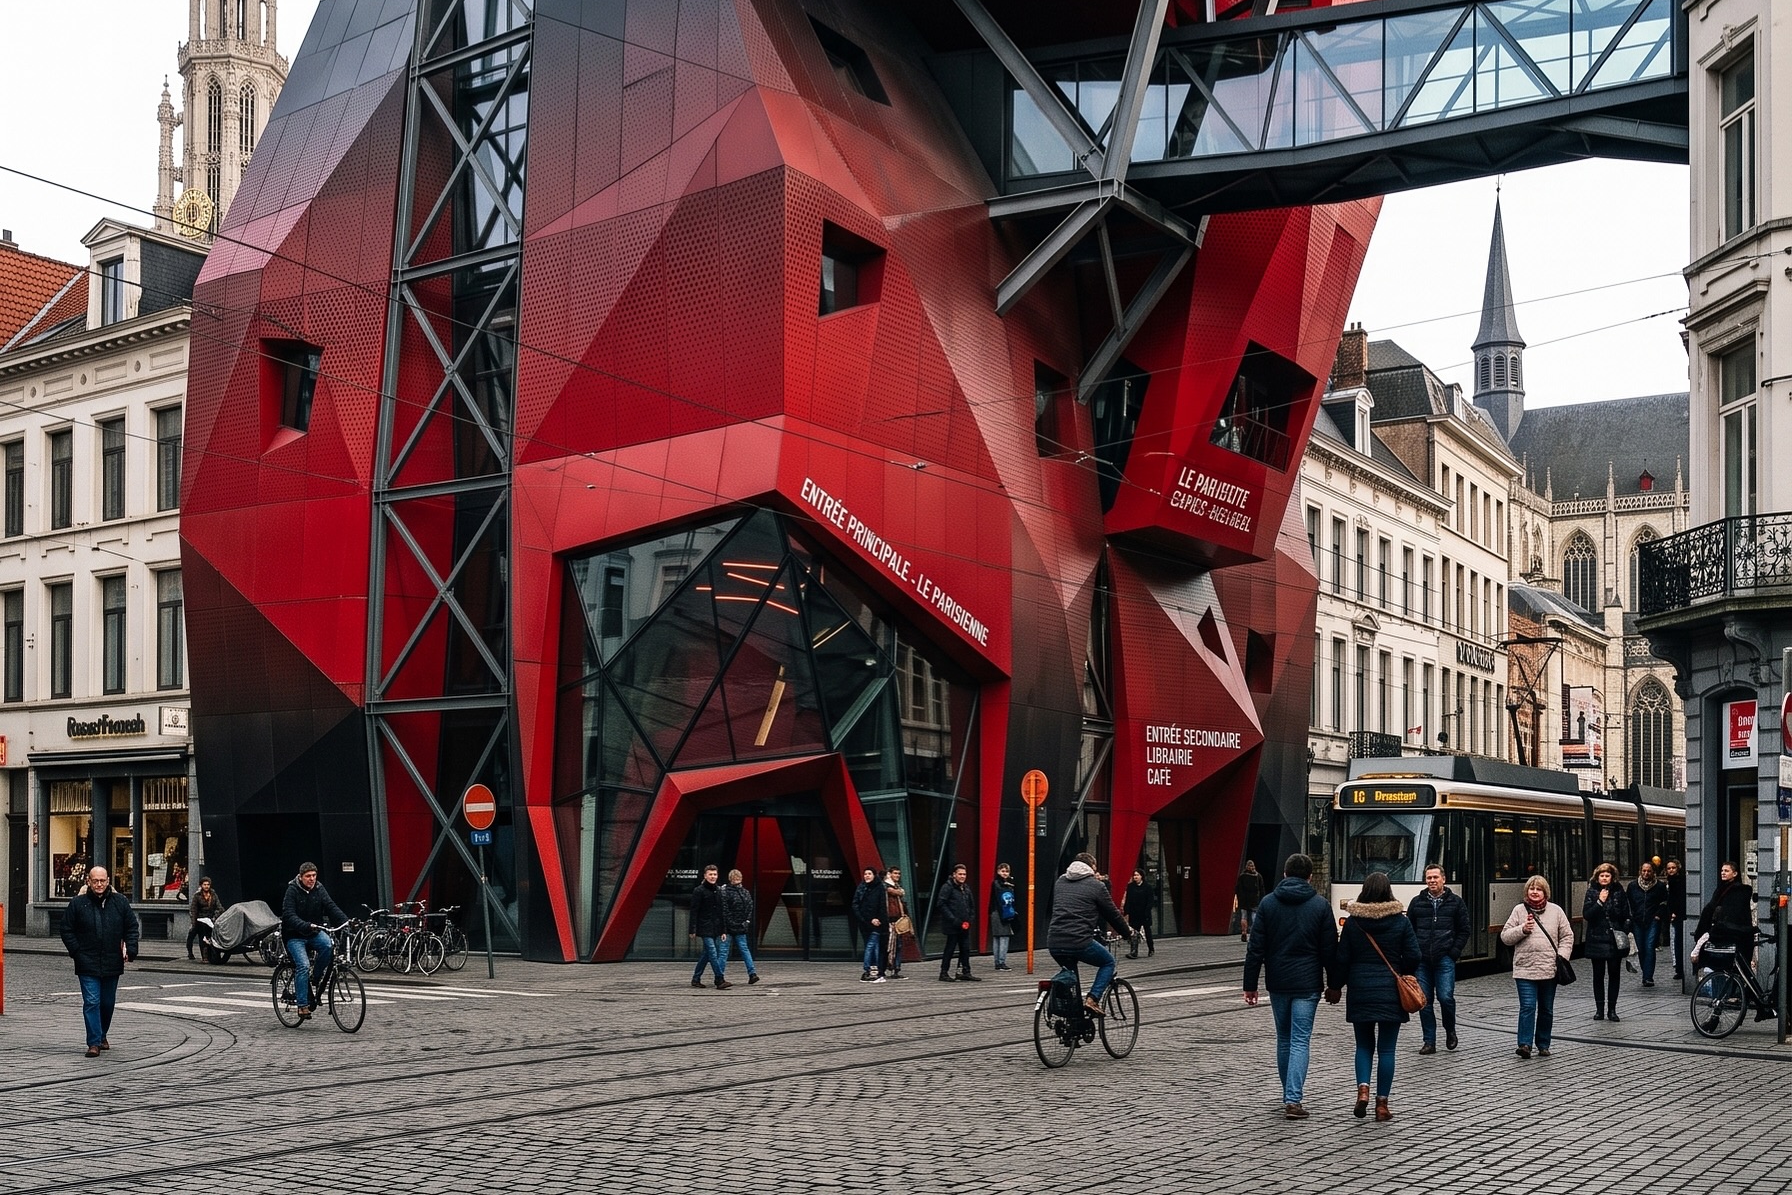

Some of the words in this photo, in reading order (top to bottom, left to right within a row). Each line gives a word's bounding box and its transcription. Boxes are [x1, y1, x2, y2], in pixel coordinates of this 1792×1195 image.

[1177, 466, 1196, 489] LE
[800, 477, 848, 530] ENTRÉE
[846, 514, 911, 582] PRINCIPALE
[916, 573, 933, 600] LE
[931, 586, 989, 647] PARISIENNE
[1146, 723, 1182, 744] ENTRÉE
[1183, 728, 1241, 749] SECONDAIRE
[1146, 746, 1193, 766] LIBRAIRIE
